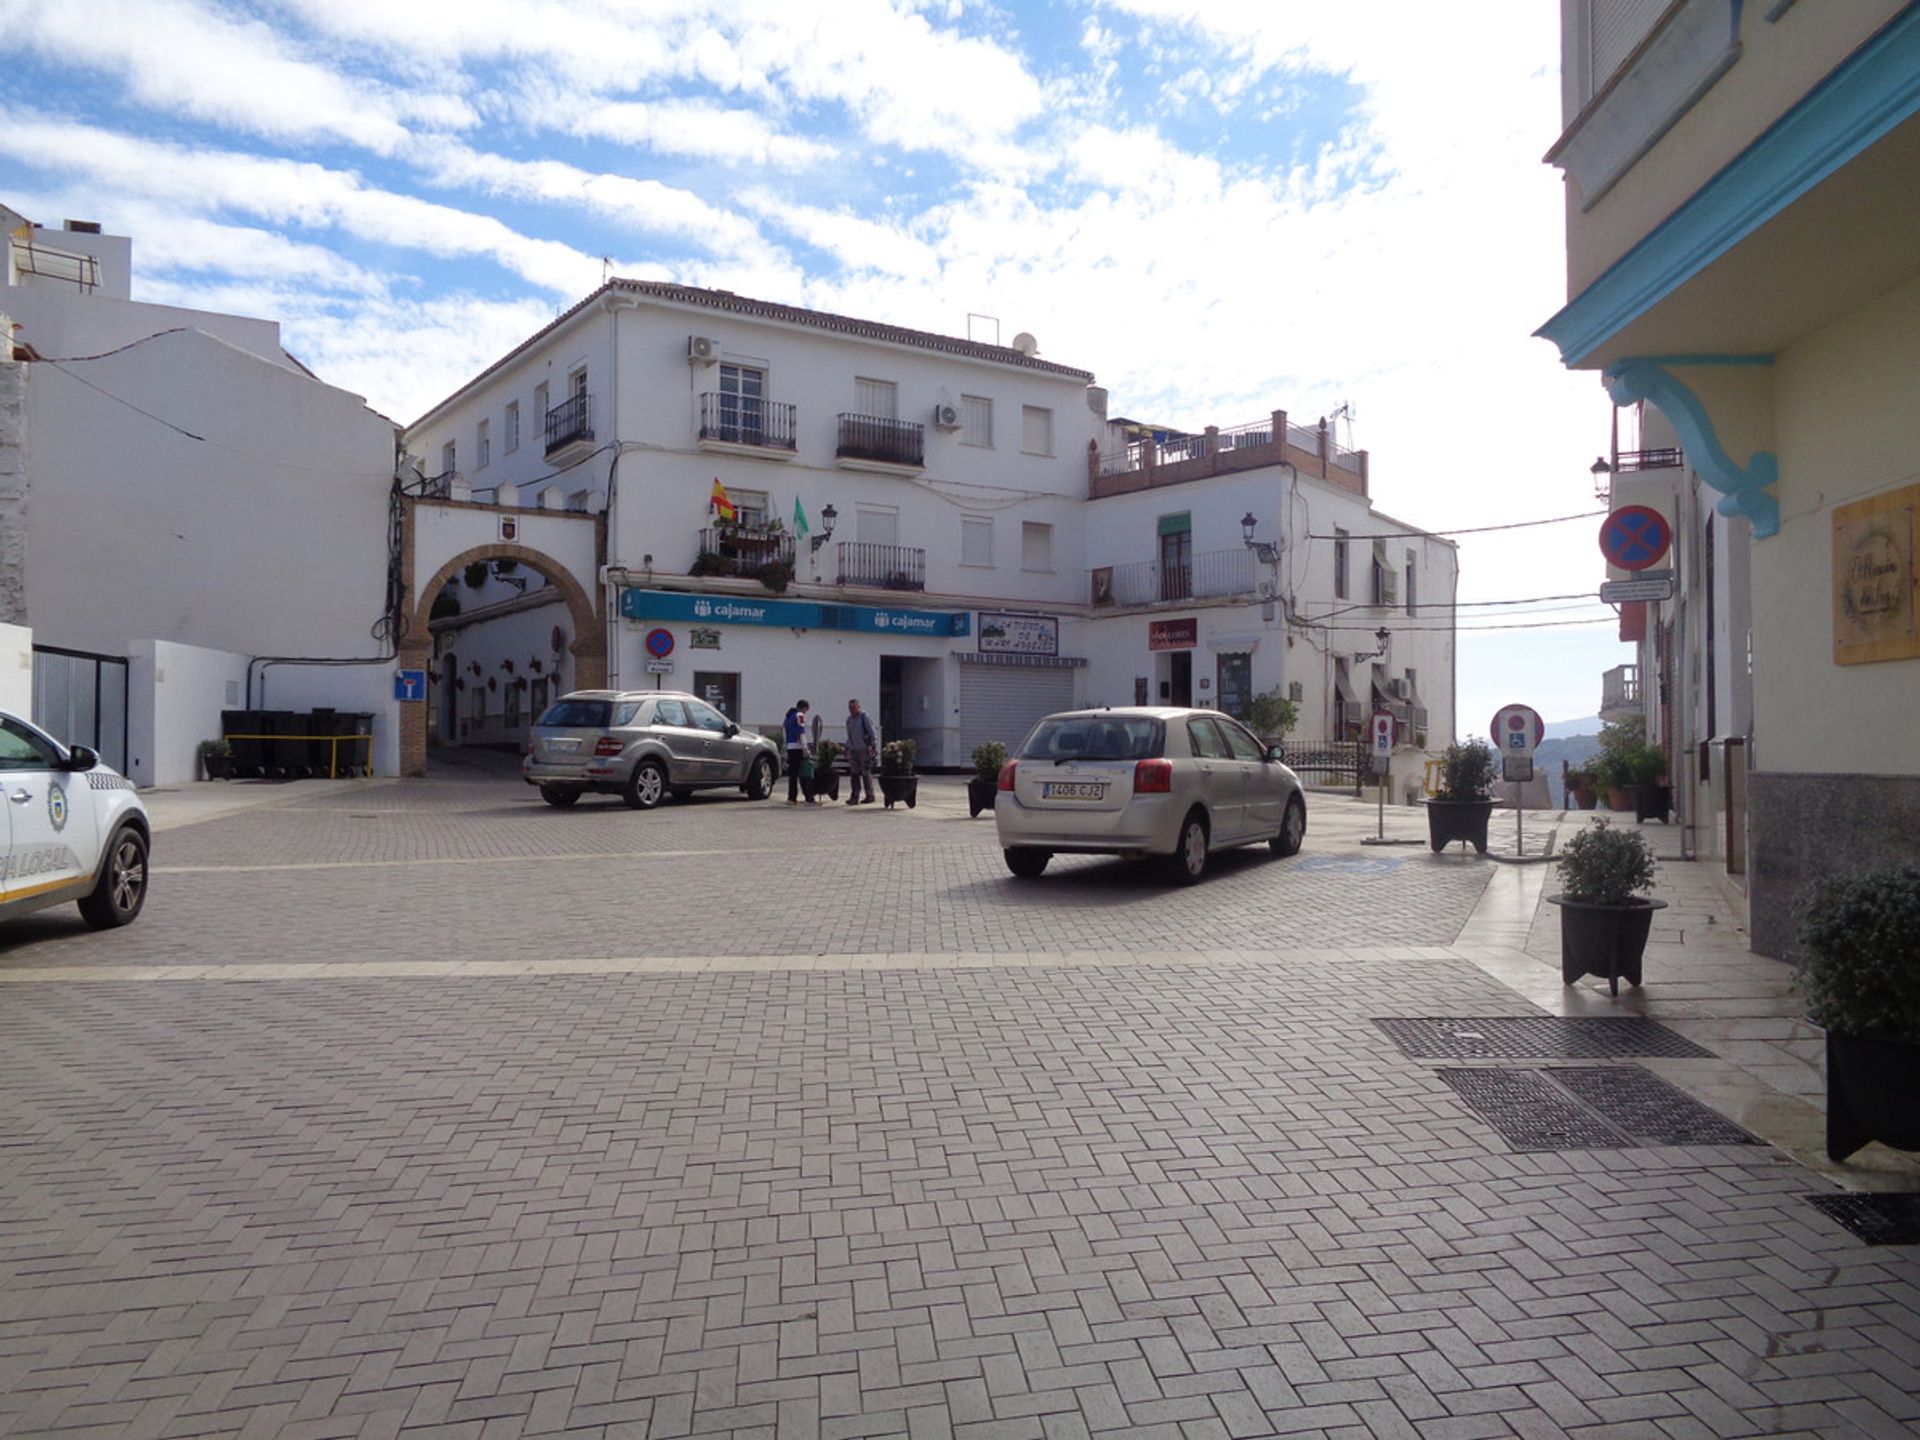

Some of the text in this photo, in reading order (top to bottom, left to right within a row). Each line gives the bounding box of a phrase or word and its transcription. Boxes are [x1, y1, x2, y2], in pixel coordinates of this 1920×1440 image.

[714, 603, 766, 619] cajamar
[891, 615, 936, 630] cajamar
[1080, 785, 1100, 797] CJZ
[18, 846, 68, 877] LOCAL
